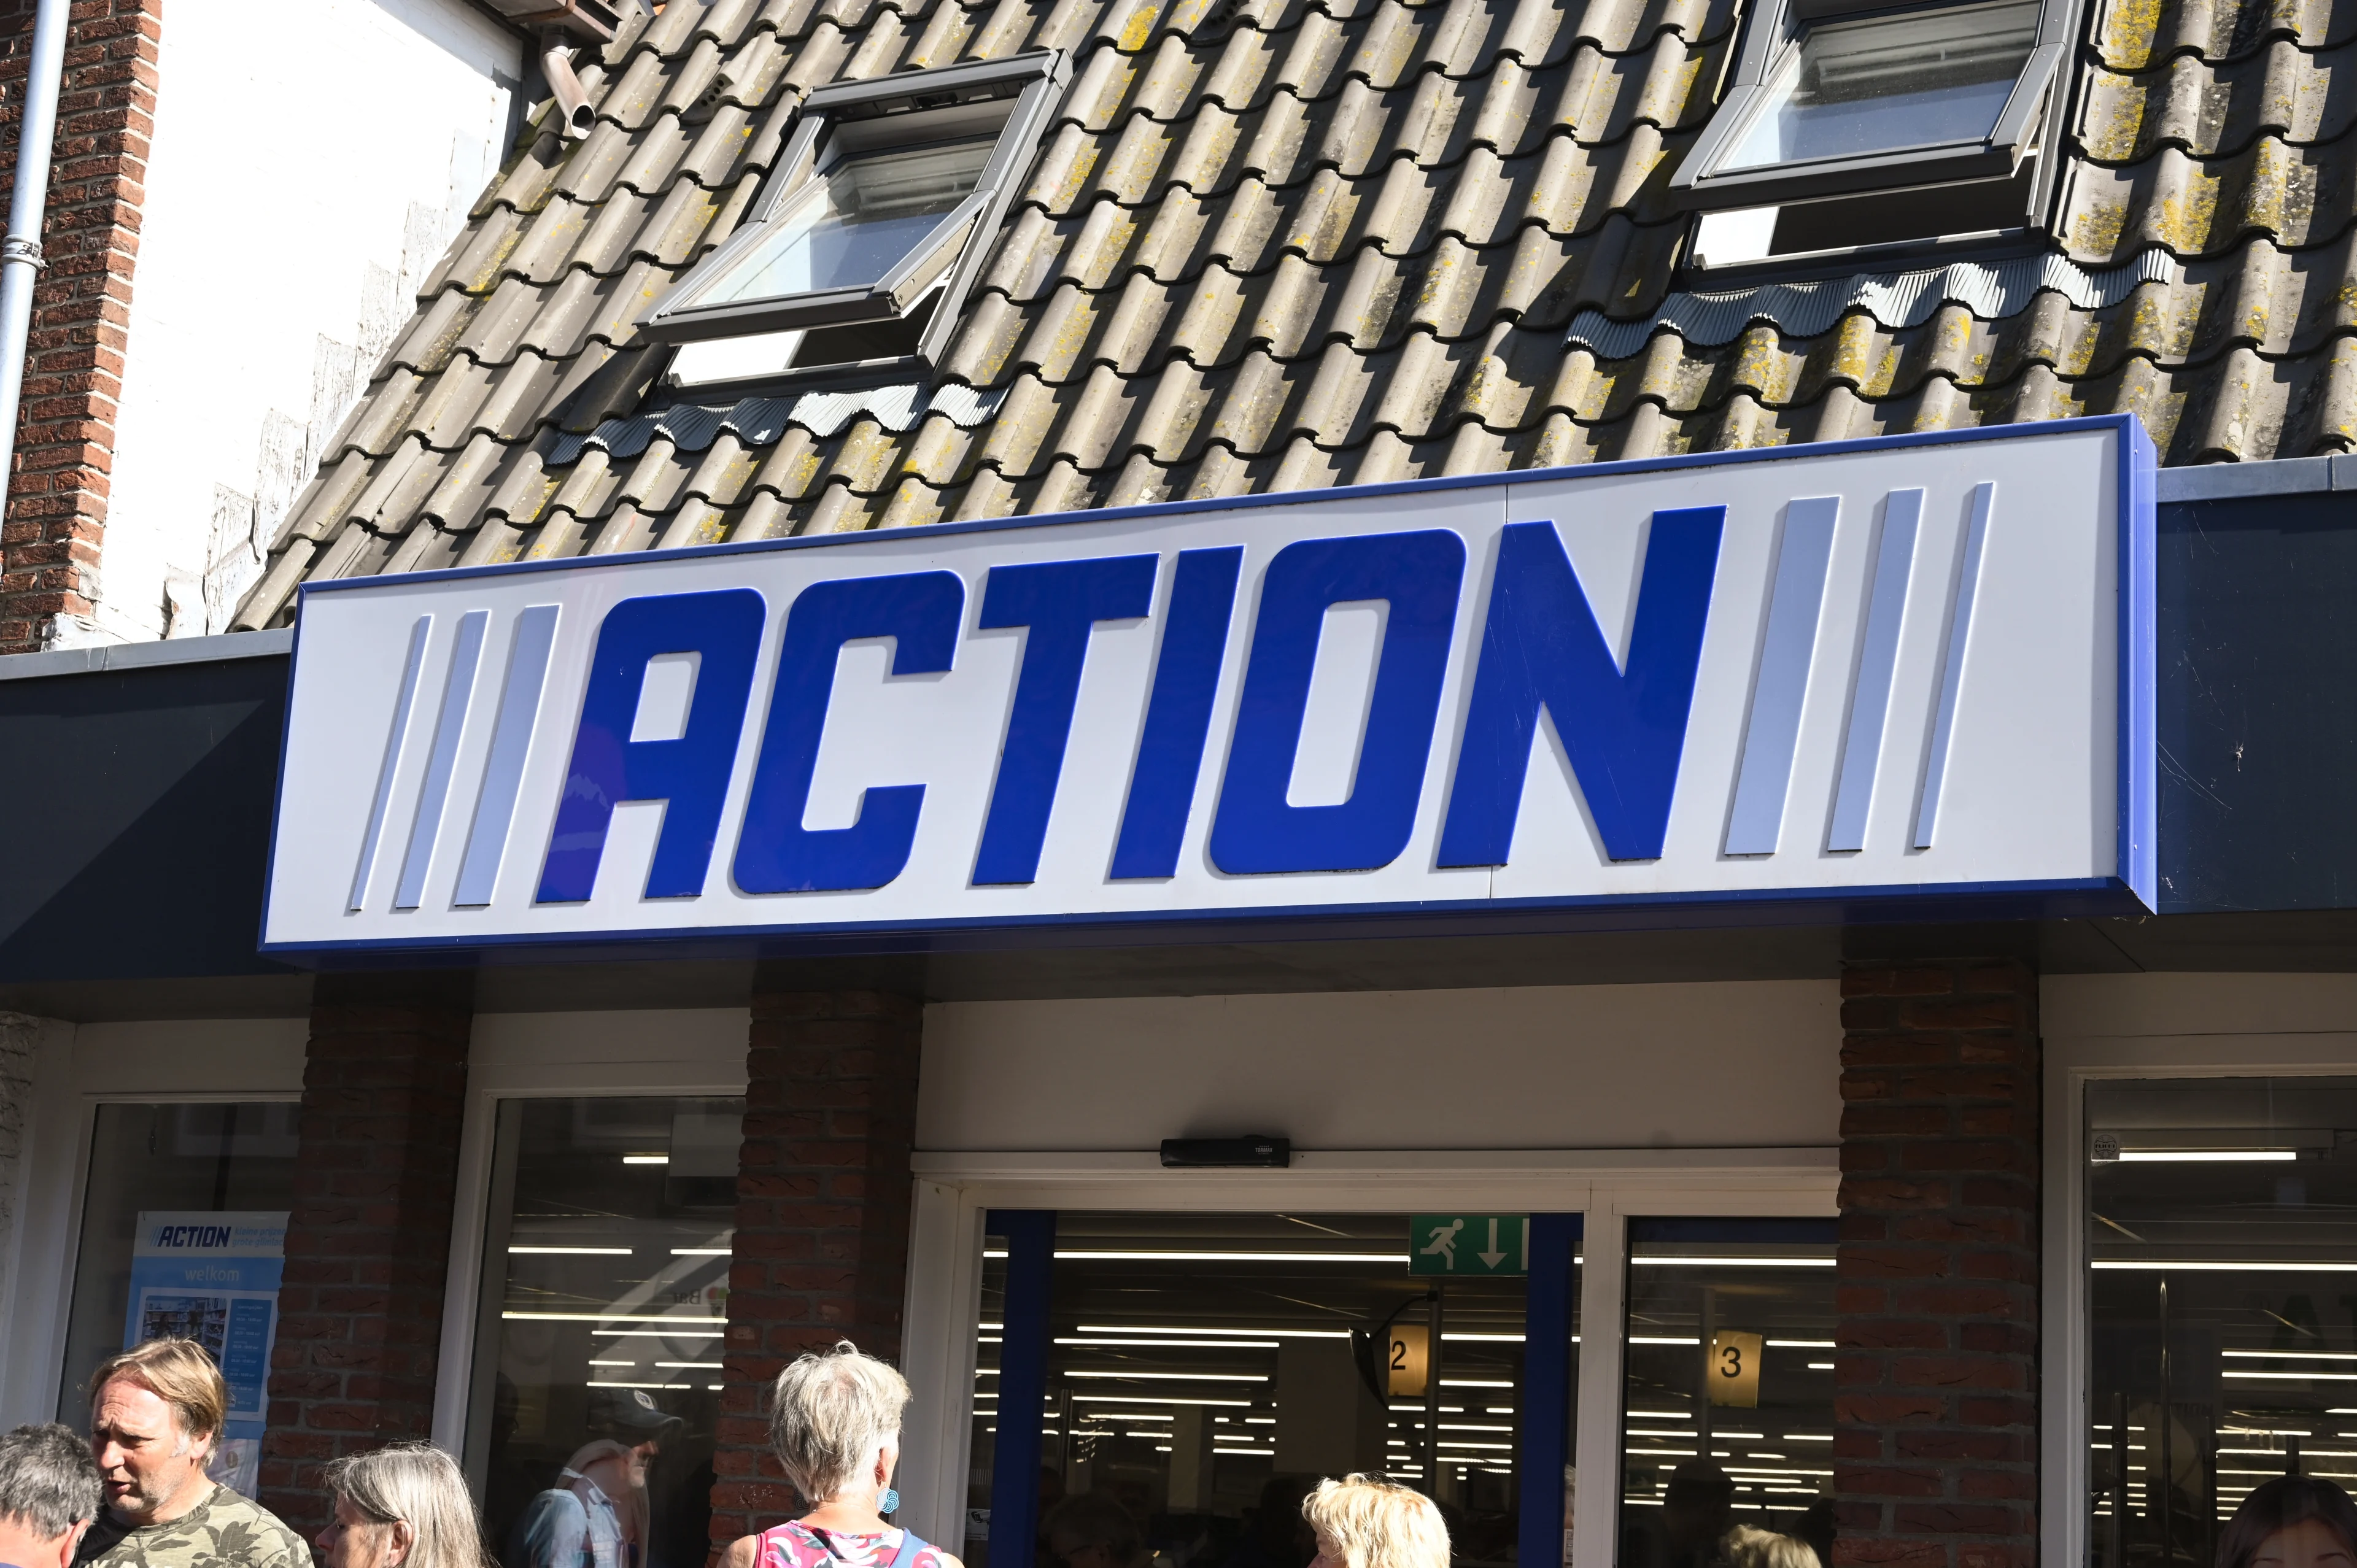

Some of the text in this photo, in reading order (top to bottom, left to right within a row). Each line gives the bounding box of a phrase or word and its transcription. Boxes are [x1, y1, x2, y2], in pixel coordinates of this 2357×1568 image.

[534, 504, 1728, 903] ACTION
[157, 1226, 232, 1248] ACTION
[234, 1226, 258, 1235] kleine
[232, 1237, 284, 1248] grote glimlac
[185, 1265, 239, 1281] welkom
[1391, 1340, 1406, 1370] 2
[1721, 1346, 1741, 1378] 3
